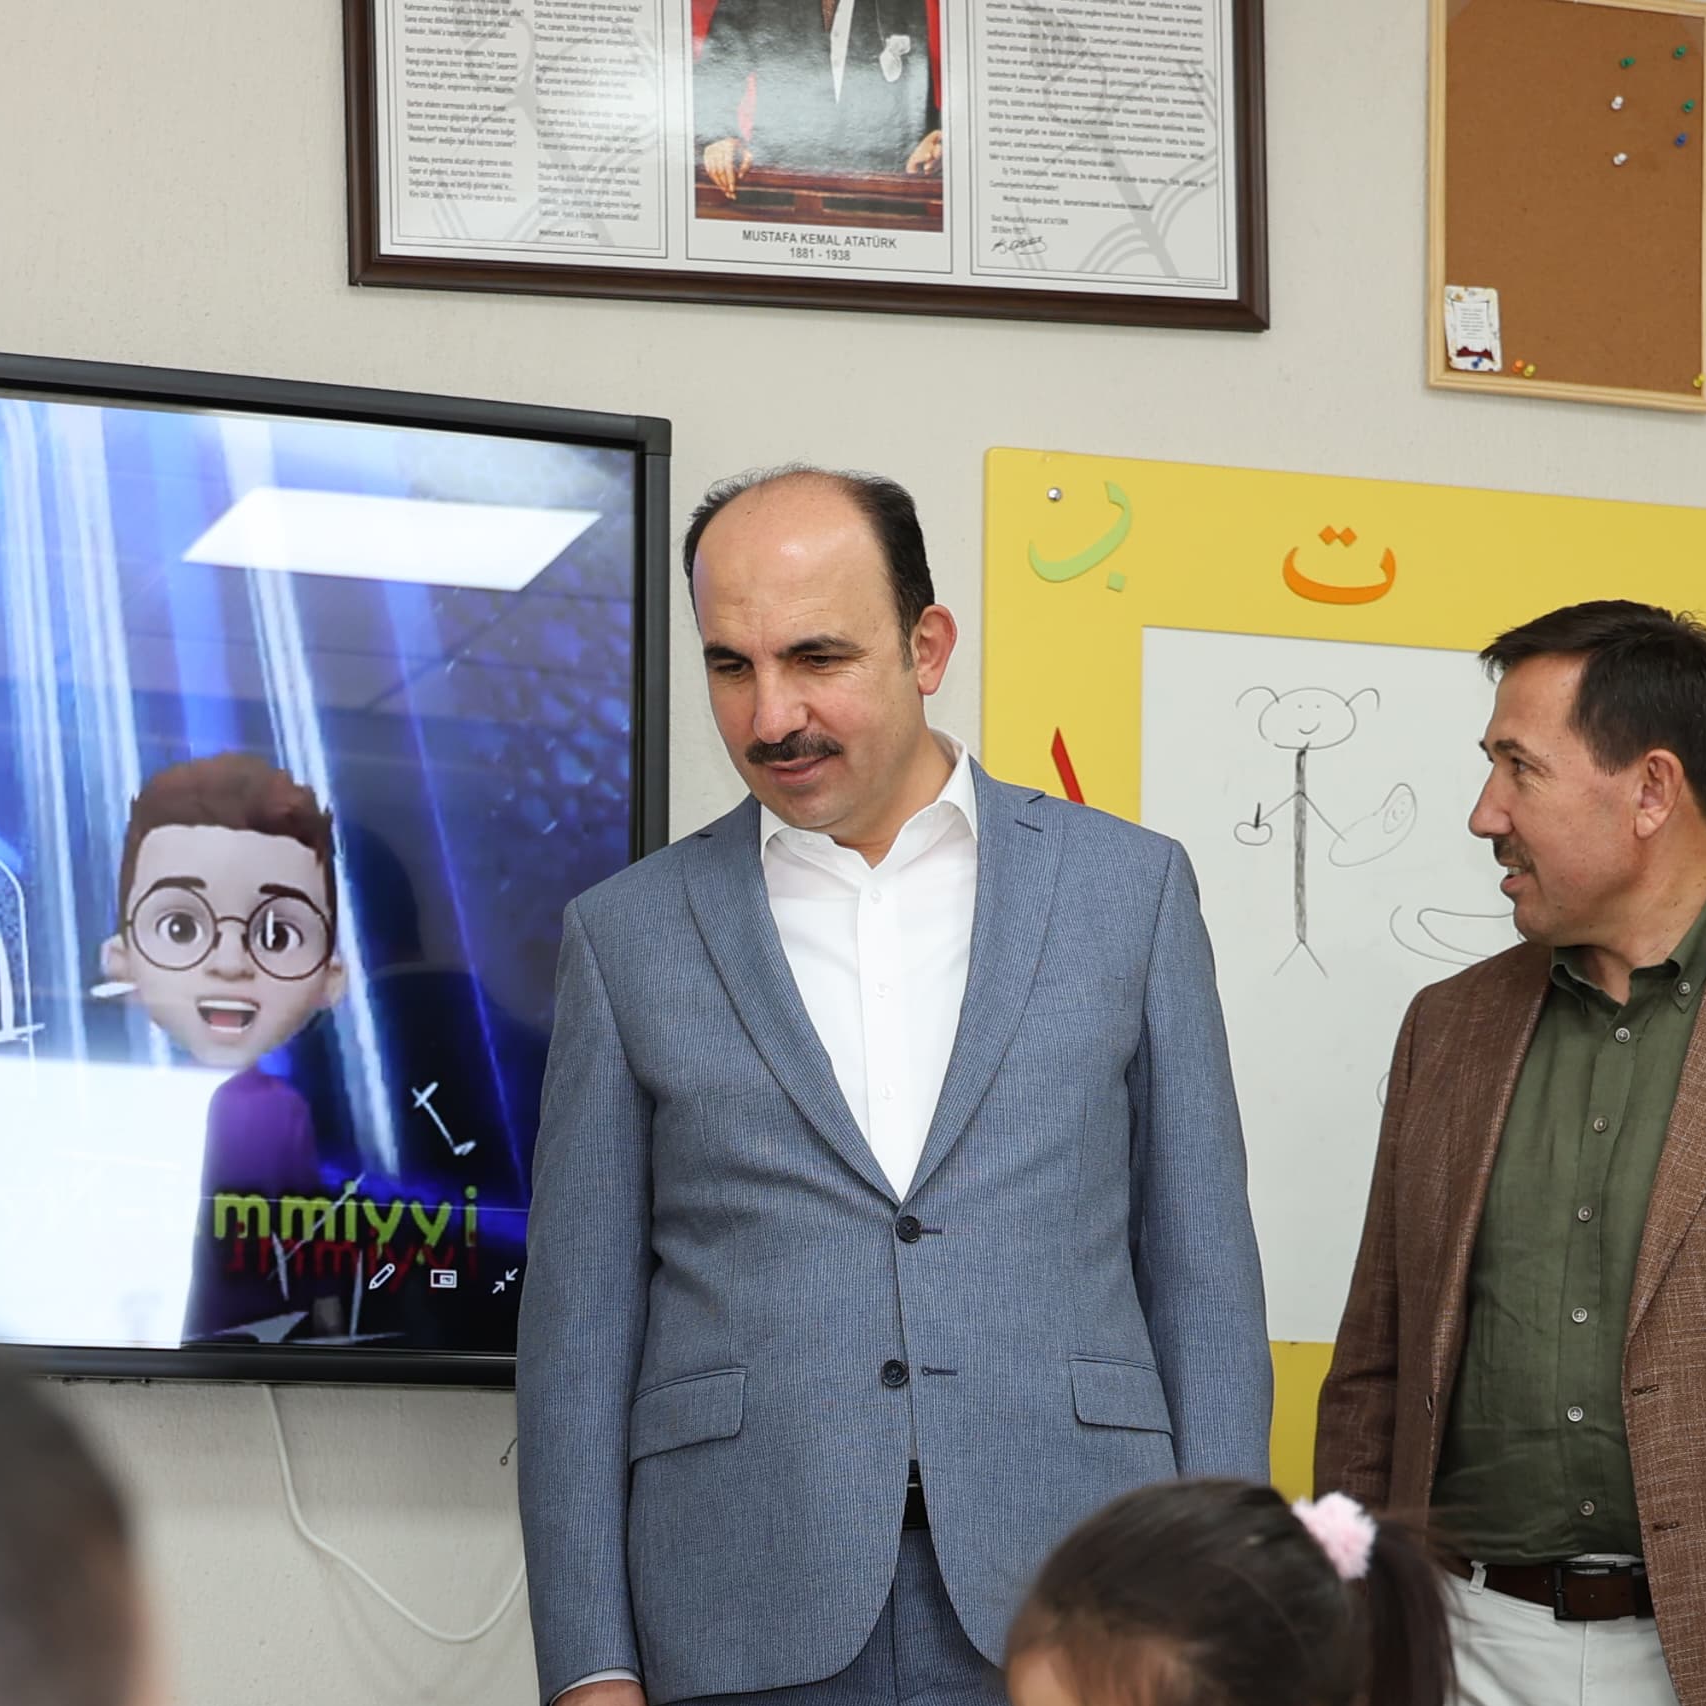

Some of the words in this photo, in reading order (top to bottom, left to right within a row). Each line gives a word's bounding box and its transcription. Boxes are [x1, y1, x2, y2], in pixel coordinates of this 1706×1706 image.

[742, 230, 797, 244] MUSTAFA
[800, 233, 841, 247] KEMAL
[844, 234, 897, 249] ATATÜRK
[790, 247, 815, 260] 1881
[826, 249, 851, 262] 1938
[1282, 525, 1397, 606] ت
